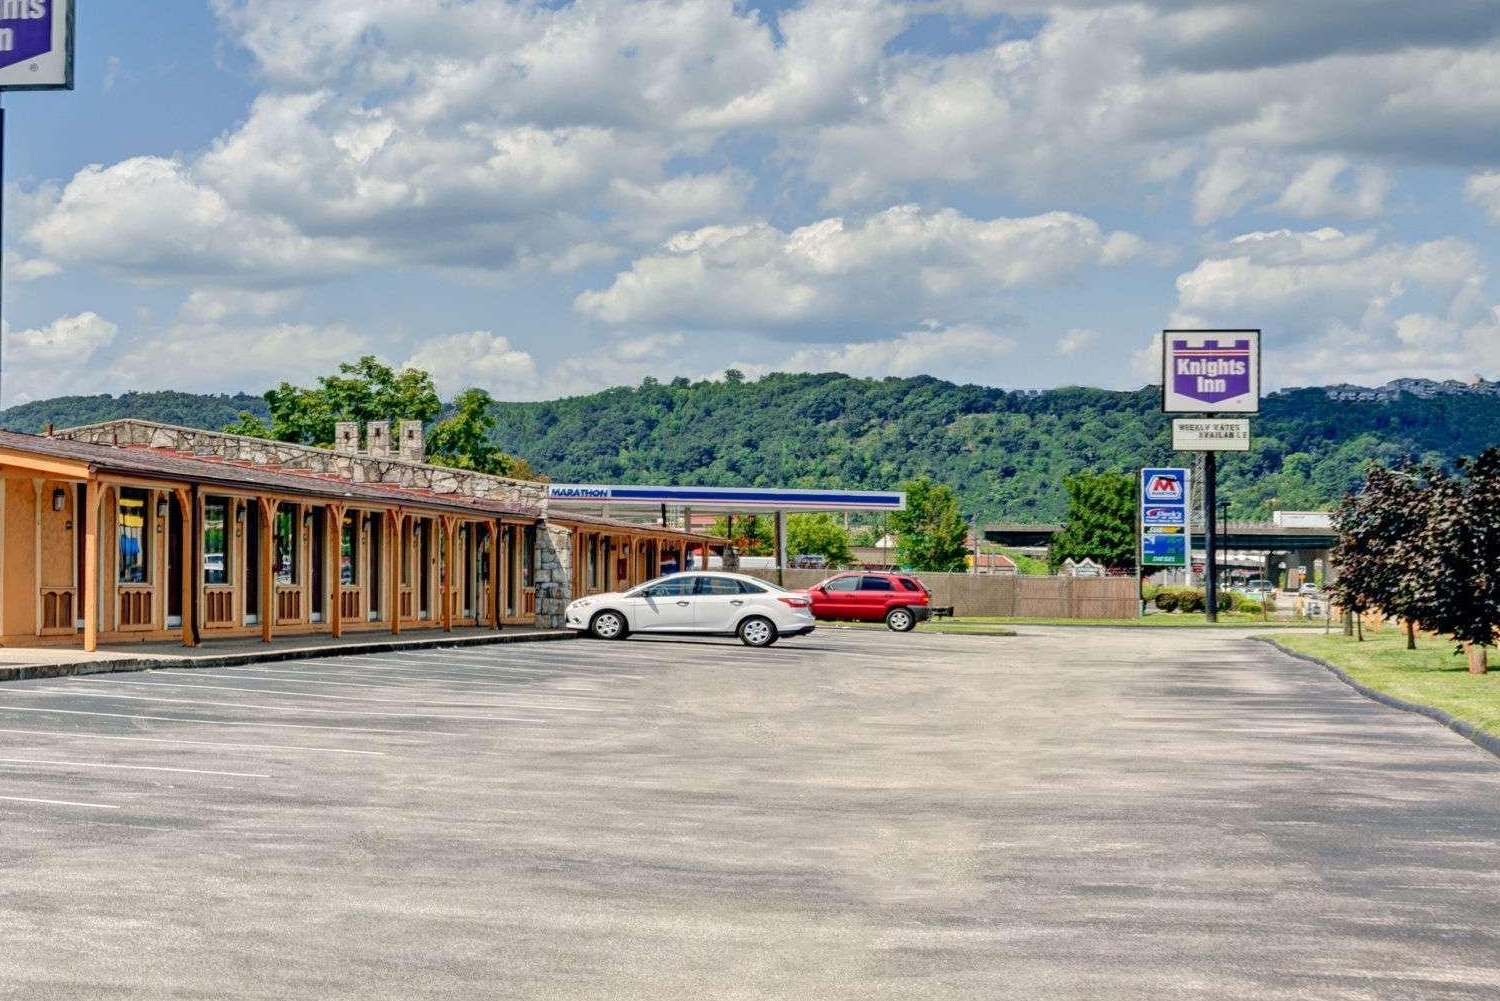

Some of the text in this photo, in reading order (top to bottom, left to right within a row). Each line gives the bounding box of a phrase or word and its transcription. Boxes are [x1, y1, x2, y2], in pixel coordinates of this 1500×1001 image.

[1177, 358, 1246, 377] Knights
[1197, 376, 1227, 393] Inn
[1153, 477, 1175, 491] M
[551, 488, 608, 497] MARATHON
